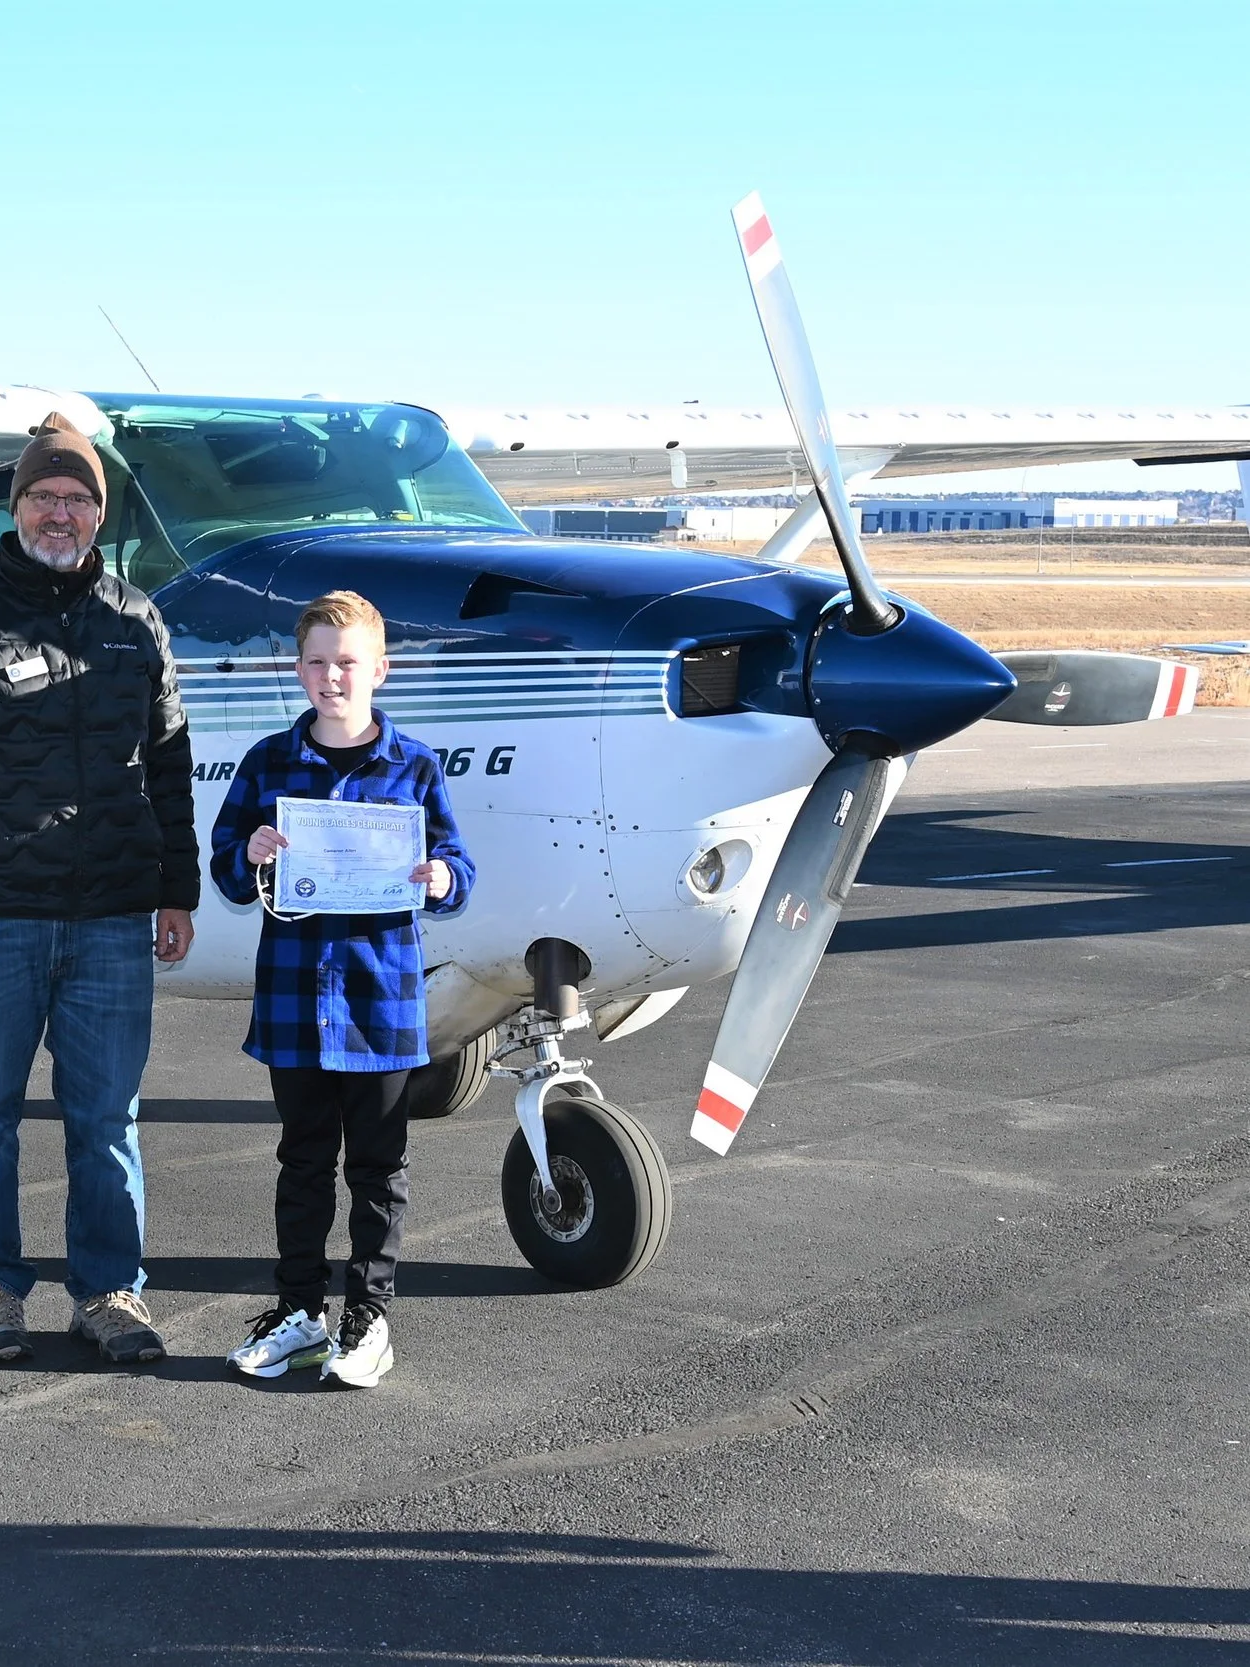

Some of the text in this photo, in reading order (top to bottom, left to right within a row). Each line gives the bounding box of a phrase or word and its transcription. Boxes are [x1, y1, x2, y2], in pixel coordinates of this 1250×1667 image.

[485, 745, 517, 776] G
[296, 816, 406, 832] YOUNG EAGLES CERTIFICATE
